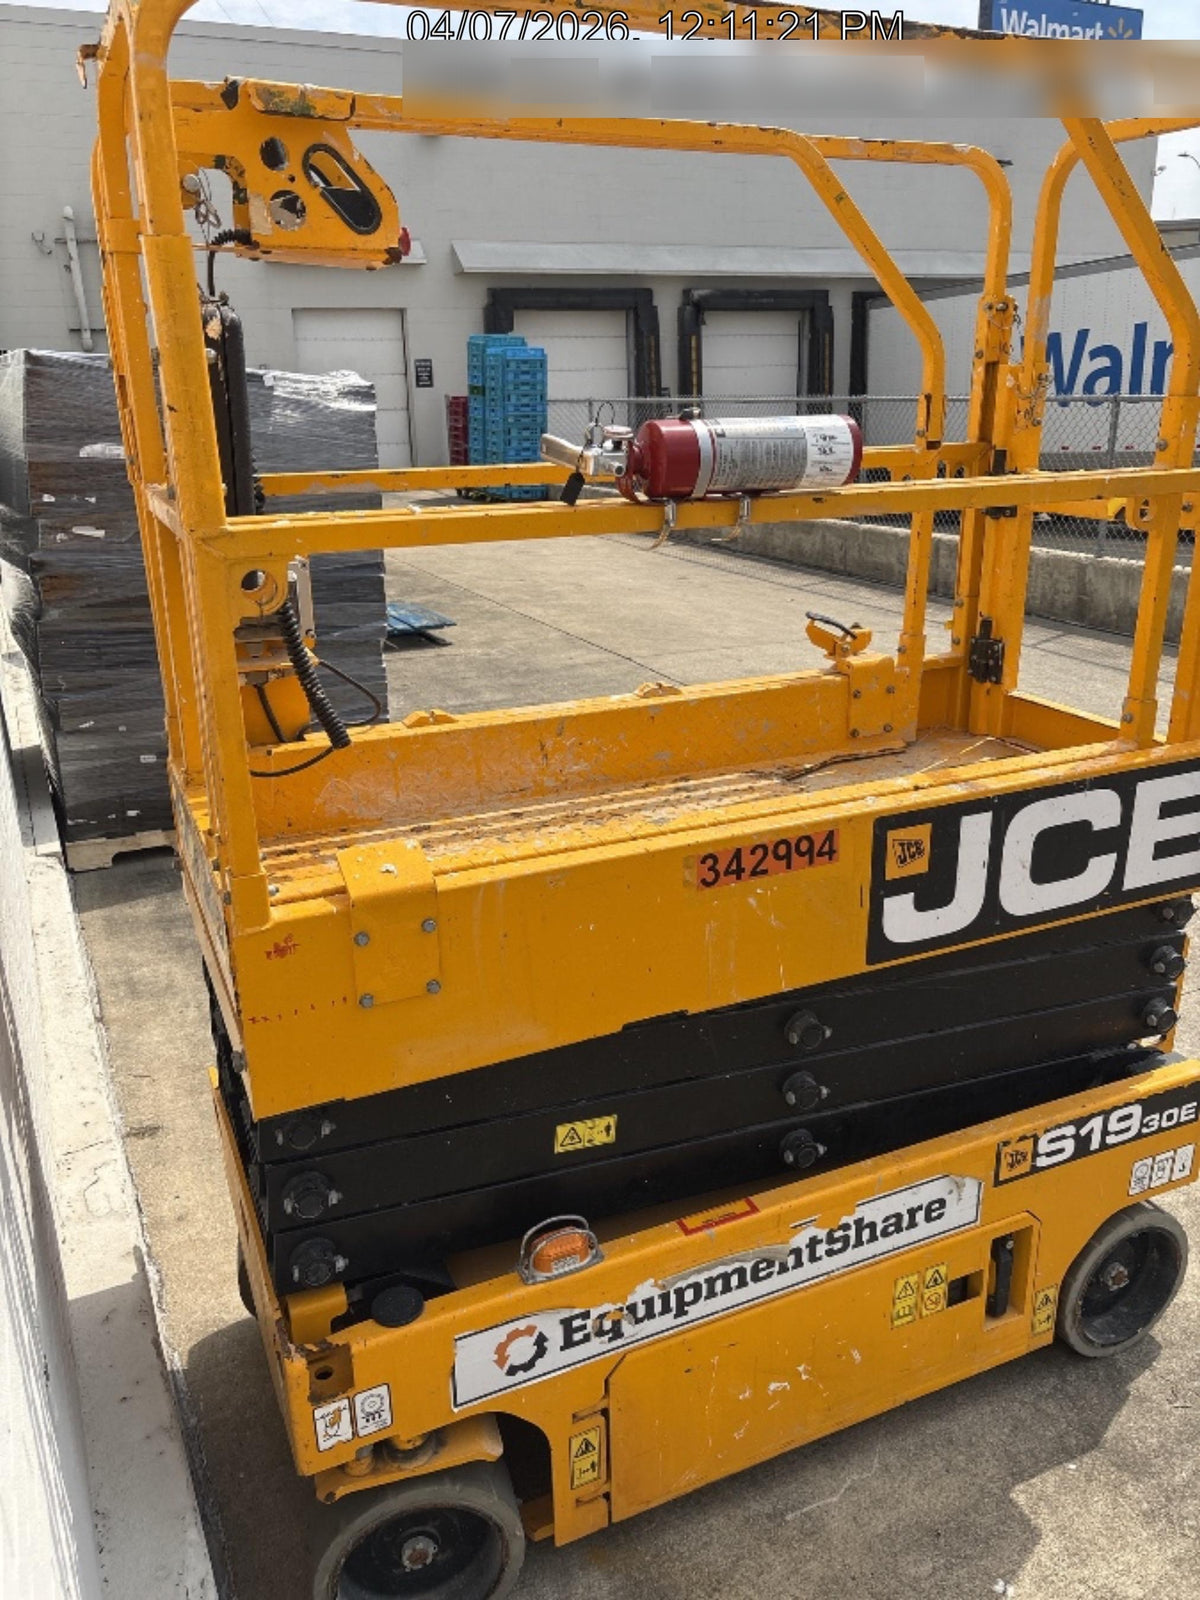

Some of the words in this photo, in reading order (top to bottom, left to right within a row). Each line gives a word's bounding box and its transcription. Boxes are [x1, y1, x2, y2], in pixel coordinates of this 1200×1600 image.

[1000, 8, 1104, 40] Walmart
[700, 829, 836, 887] 342994
[559, 1197, 947, 1352] EquipmentShare
